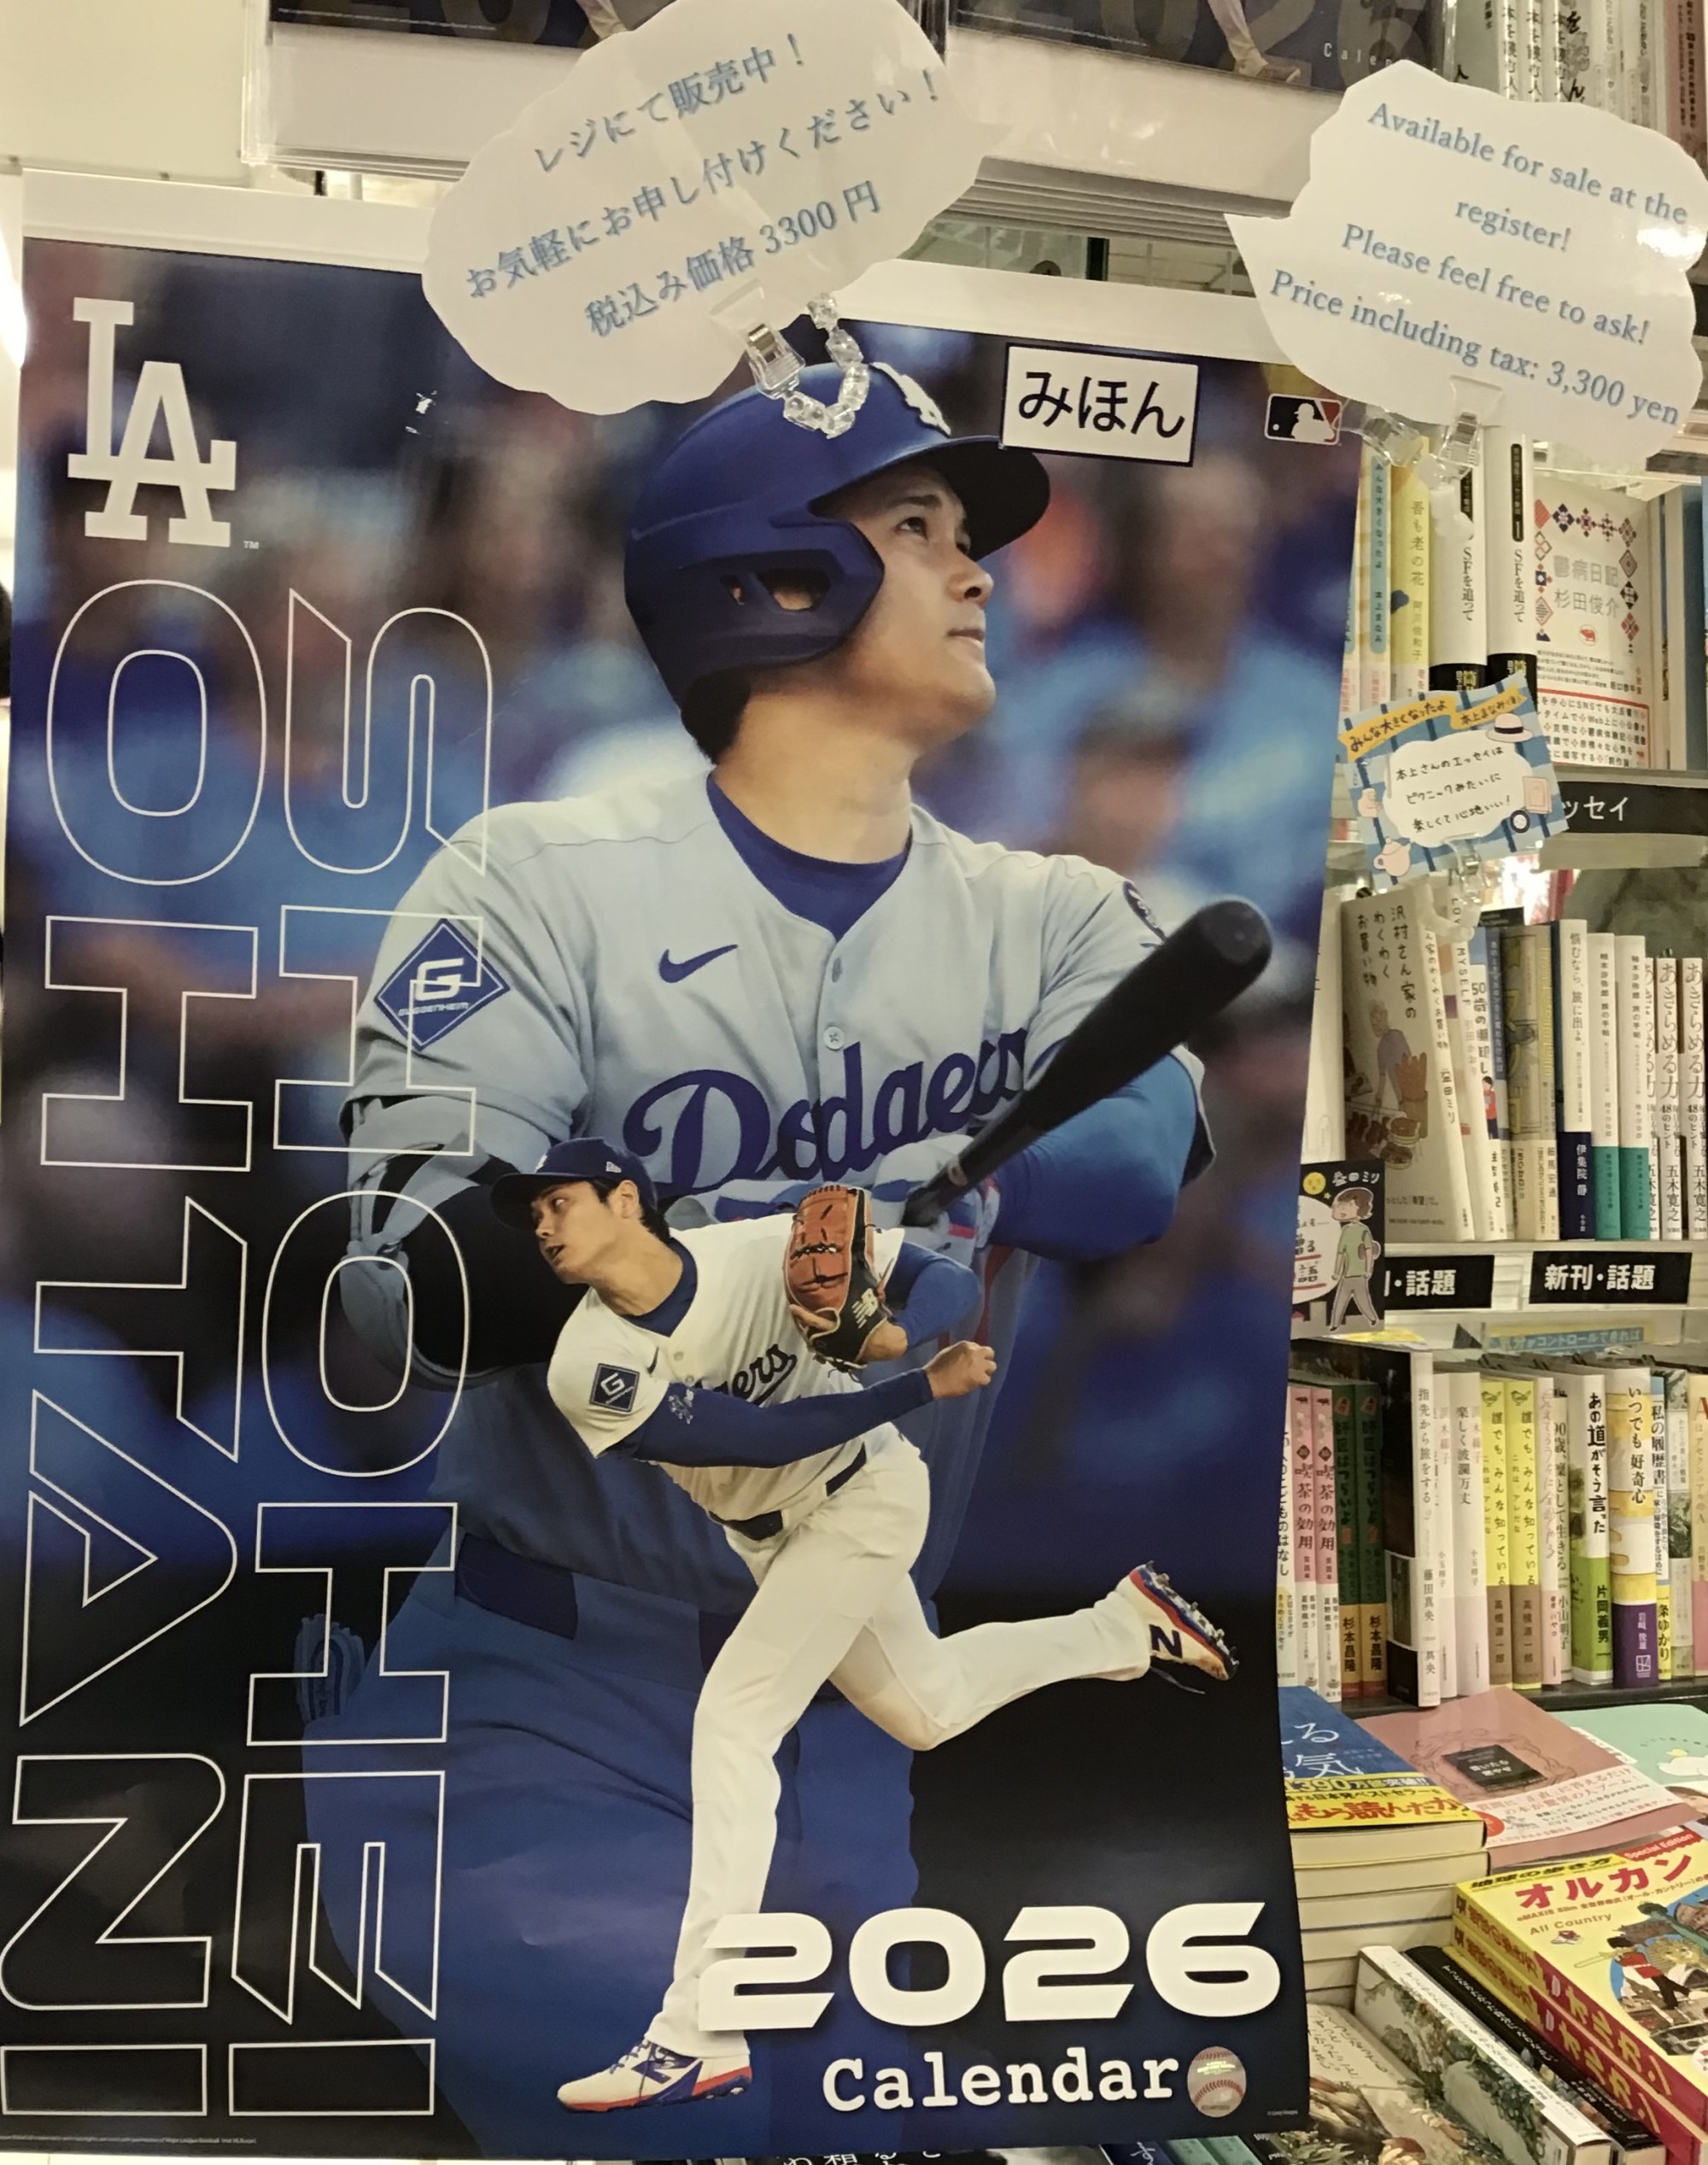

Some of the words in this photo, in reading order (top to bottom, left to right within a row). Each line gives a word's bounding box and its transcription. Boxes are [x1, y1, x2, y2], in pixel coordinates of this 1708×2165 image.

[534, 32, 806, 173] レジにて販売中！
[467, 68, 939, 301] お気軽にお申し付けください！
[1367, 102, 1495, 162] Available
[1501, 145, 1544, 176] for
[1548, 166, 1602, 197] sale
[1610, 185, 1637, 208] at
[1644, 191, 1688, 225] the
[585, 236, 756, 338] 税込み価格
[765, 200, 839, 256] 3300
[842, 179, 881, 225] 円
[1454, 197, 1572, 254] register!
[1341, 223, 1431, 274] Please
[1437, 255, 1492, 294] feel
[1496, 273, 1552, 315] free
[1558, 299, 1587, 325] to
[1593, 313, 1651, 347] ask!
[1269, 269, 1343, 317] Price
[1350, 295, 1483, 367] including
[1490, 343, 1538, 380] tax:
[1547, 360, 1626, 408] 3,300
[1633, 395, 1680, 429] yen
[67, 297, 237, 547] LA
[1018, 370, 1186, 439] みほん
[1410, 500, 1425, 586] 吾も老の花
[1553, 588, 1621, 619] 杉田俊介
[1349, 698, 1449, 753] みんな大きくなったよ
[1396, 745, 1505, 781] 本上さんのエッセイは
[415, 957, 465, 1001] G
[1357, 912, 1378, 988] お買い物
[1373, 909, 1392, 980] わくわく
[1390, 905, 1417, 1021] 沢村さん家の
[1456, 946, 1472, 1006] MYSELF
[1659, 963, 1680, 1099] あきらめる力
[1685, 963, 1705, 1099] あきらめる力
[1576, 1144, 1588, 1180] 伊集院
[1666, 1164, 1681, 1222] 五木寛之
[1693, 1164, 1707, 1222] 五木寛之
[1383, 1268, 1457, 1296] ・話題
[1543, 1264, 1656, 1291] 新刊・話題
[0, 578, 267, 2117] OHTANI
[231, 588, 494, 2117] SHOHEI
[1418, 1388, 1432, 1503] 指先から旅をする
[1628, 1386, 1643, 1449] いつでも
[1455, 1406, 1472, 1506] 楽しく波瀾万丈
[1587, 1392, 1607, 1535] あの道がそう言った
[1630, 1454, 1647, 1505] 好奇心
[1295, 1462, 1314, 1550] 喫茶の効用
[1316, 1464, 1336, 1552] 喫茶の効用
[1491, 1411, 1508, 1586] 誰でも、みんな知っている
[1520, 1411, 1537, 1585] 誰でも、みんな知っている
[1342, 1616, 1357, 1673] 杉本昌隆
[1370, 1615, 1383, 1671] 杉本昌隆
[1596, 1584, 1611, 1644] 片岡義男
[1469, 1856, 1614, 1890] 地球の歩き方
[1515, 1854, 1692, 1910] オルカン
[1623, 1841, 1661, 1861] Special
[1660, 1832, 1694, 1851] Edition
[1530, 1923, 1551, 1936] All
[1553, 1912, 1613, 1930] Country
[698, 1901, 1282, 2033] 2026
[822, 2045, 1180, 2115] Calendar
